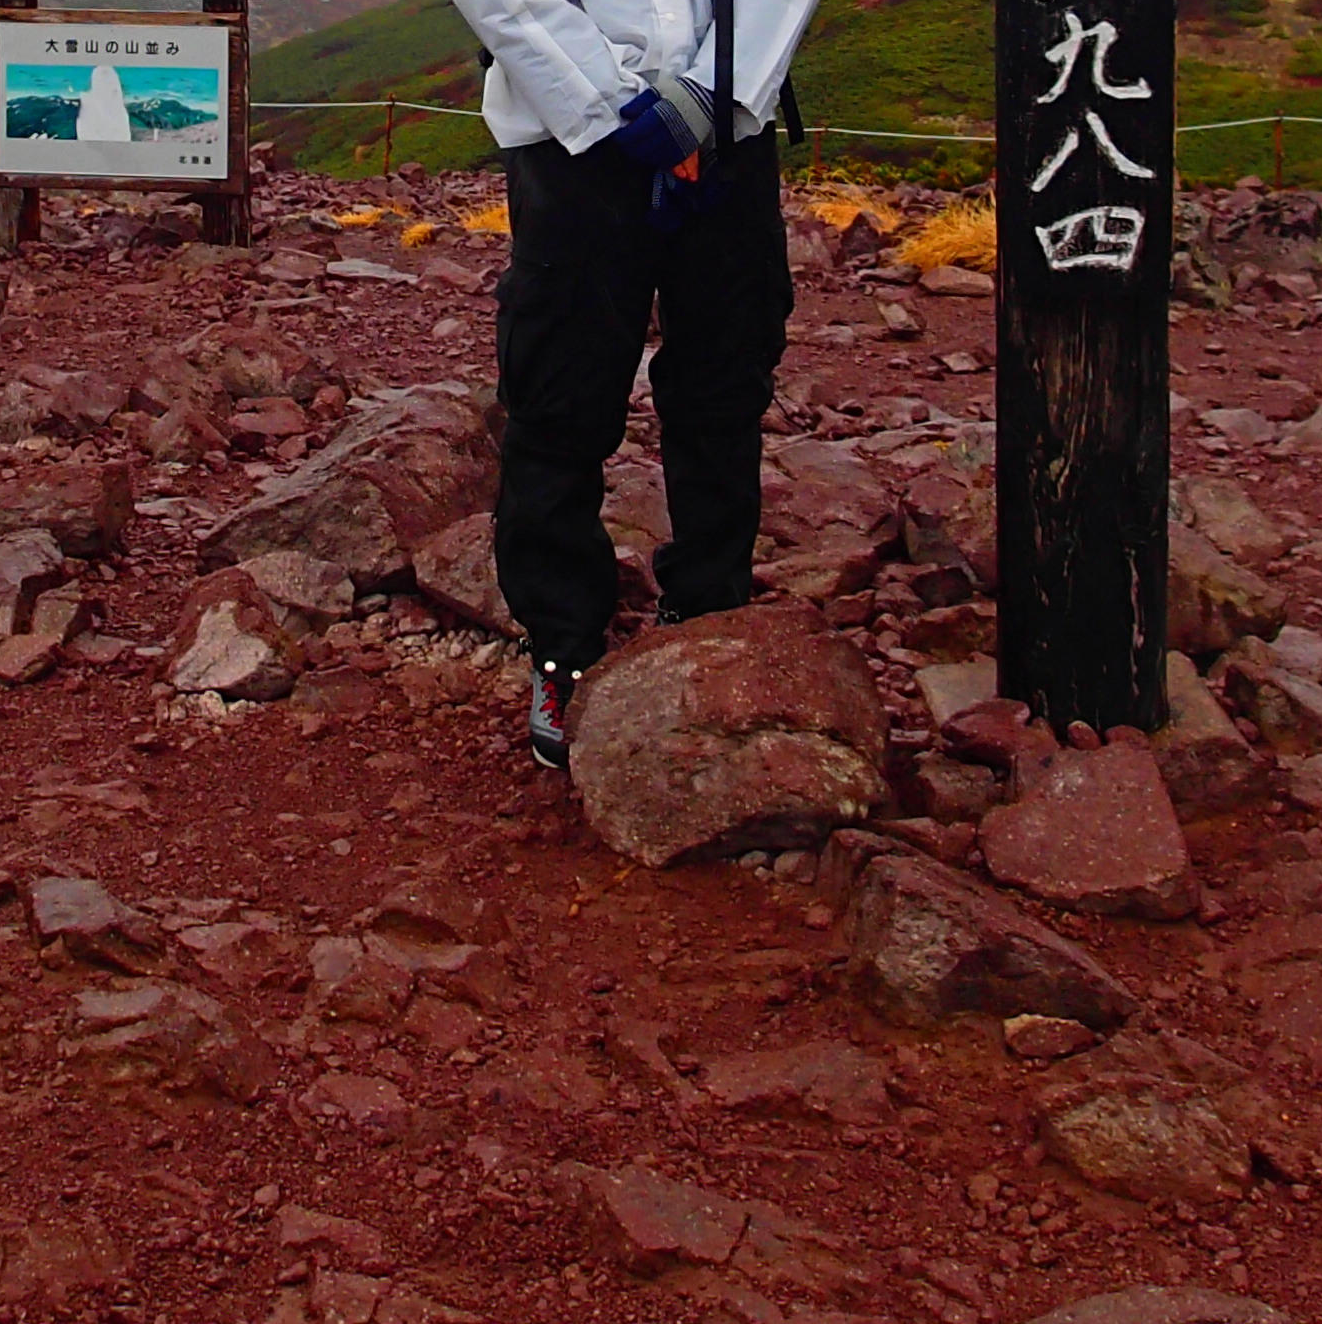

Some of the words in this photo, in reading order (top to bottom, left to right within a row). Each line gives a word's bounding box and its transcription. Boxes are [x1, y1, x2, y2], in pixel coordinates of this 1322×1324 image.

[45, 39, 179, 55] 大雪山の山並み
